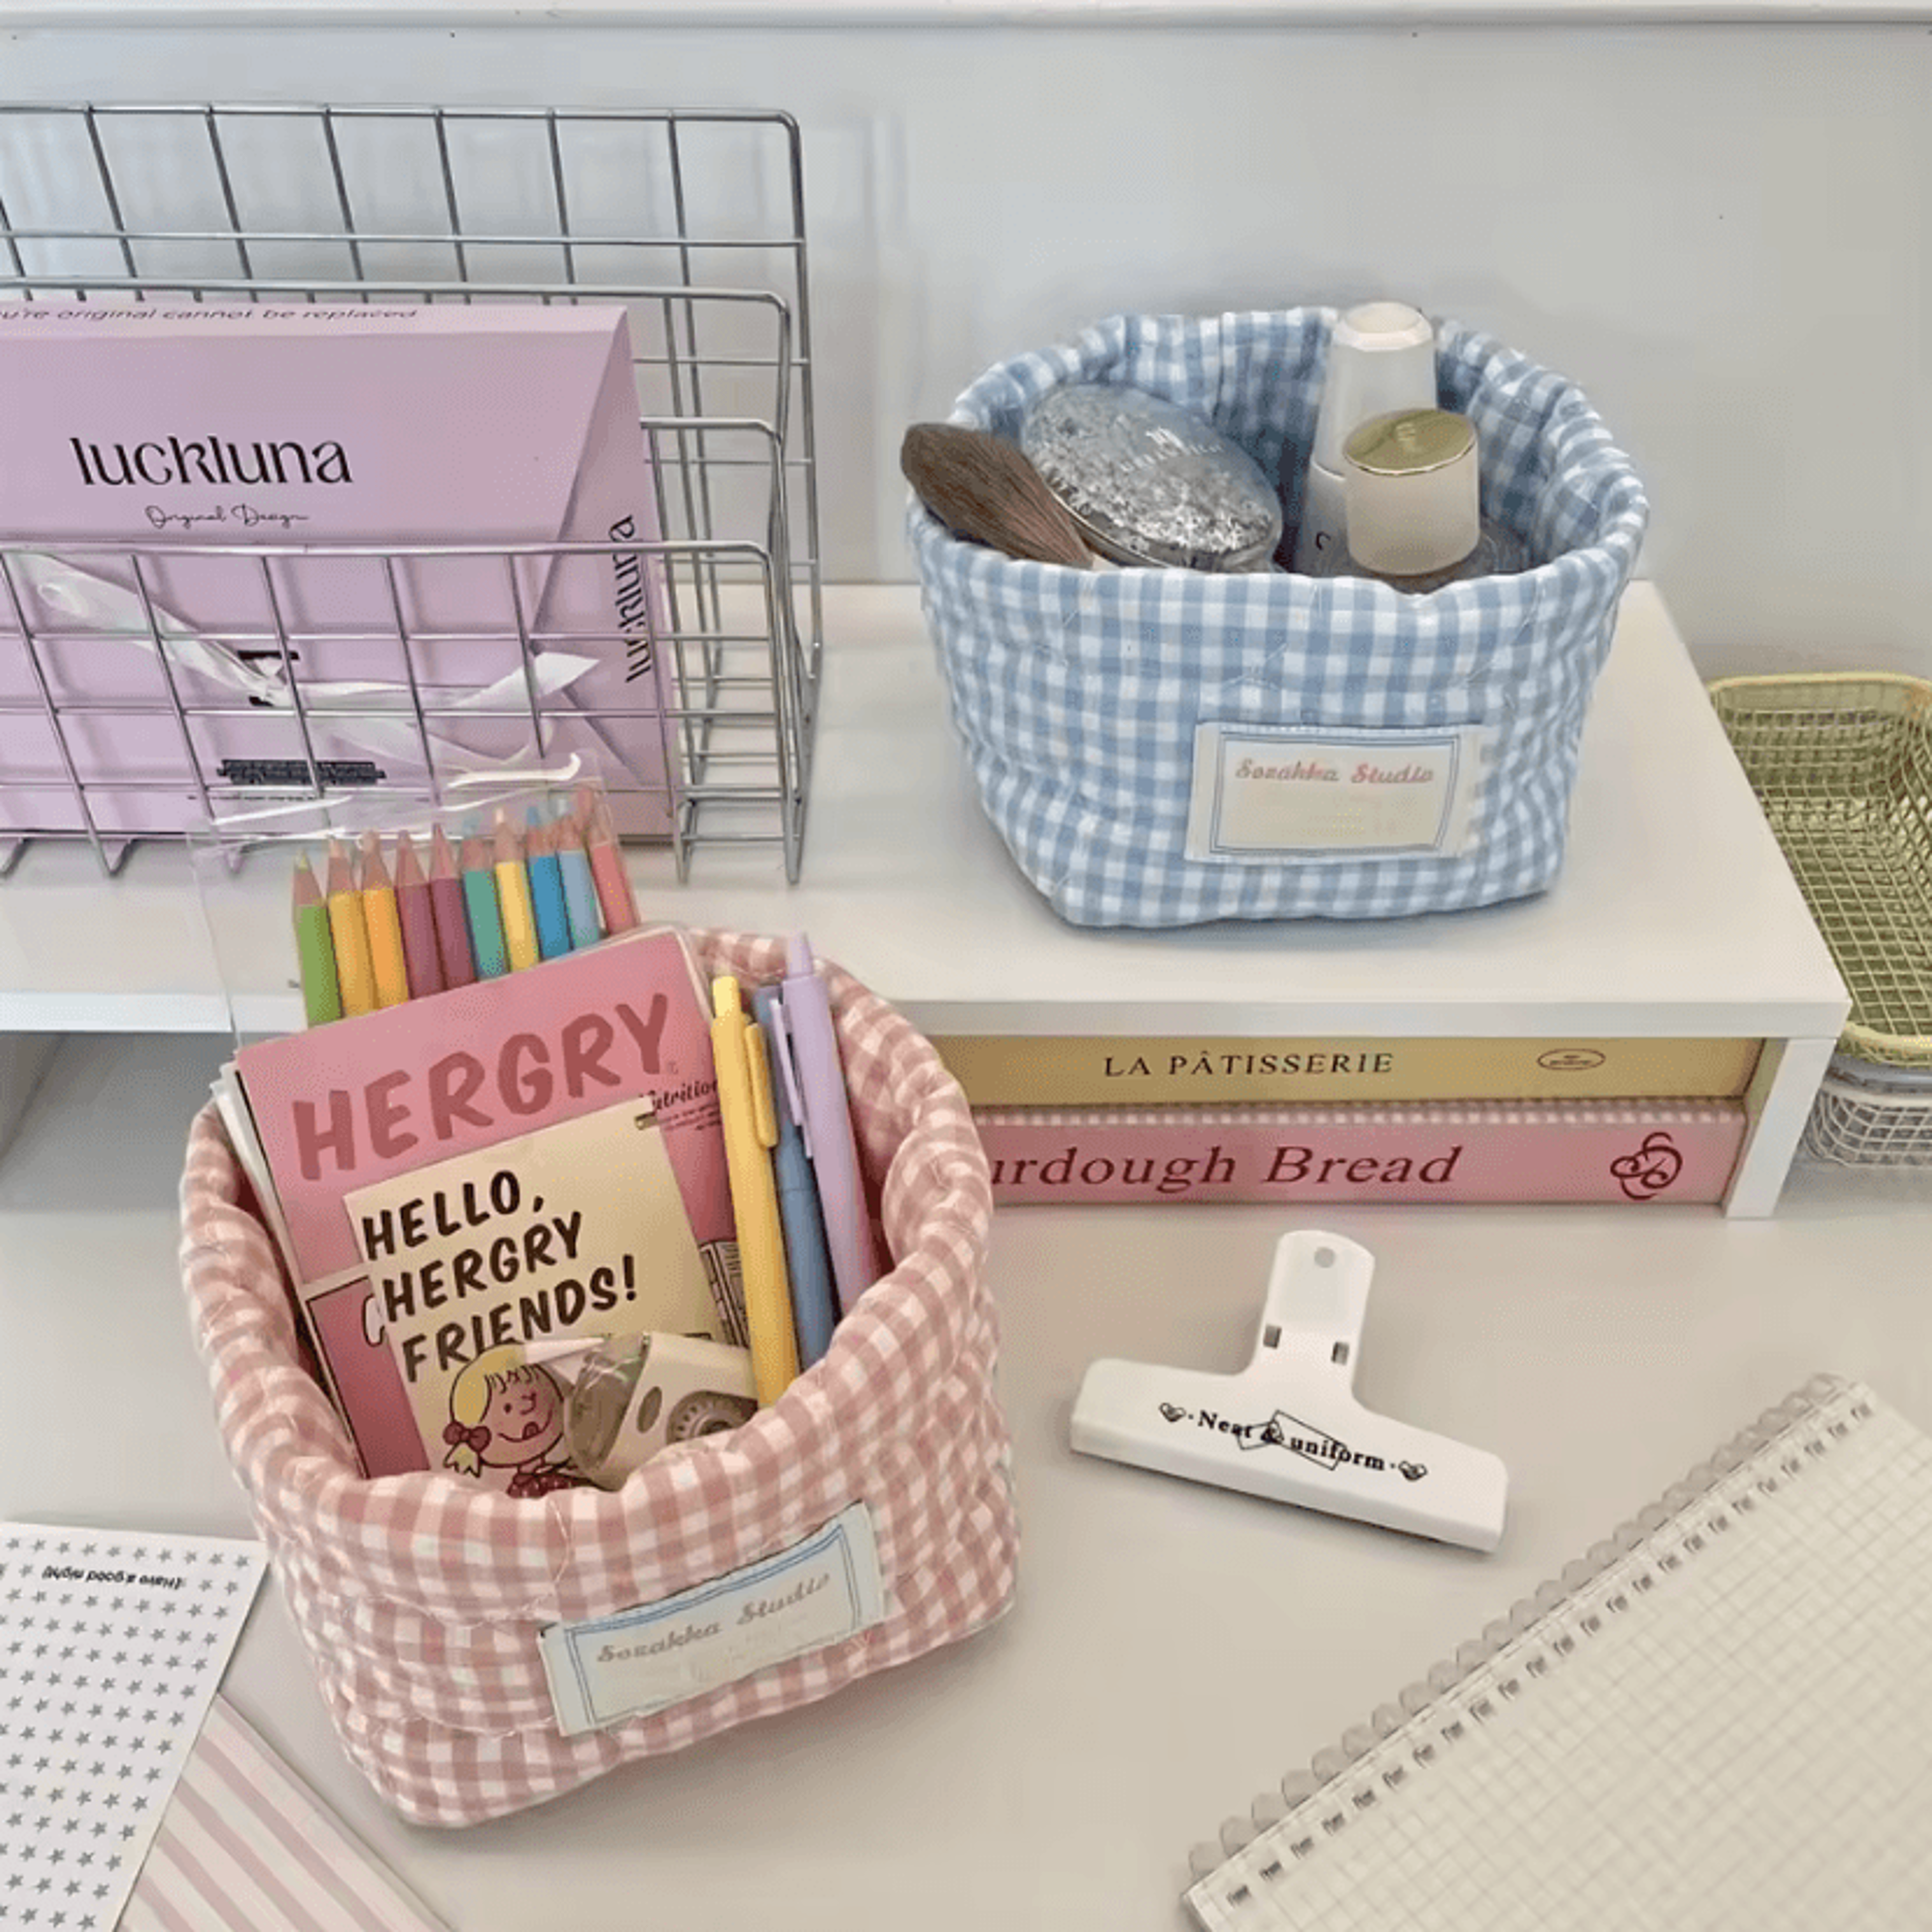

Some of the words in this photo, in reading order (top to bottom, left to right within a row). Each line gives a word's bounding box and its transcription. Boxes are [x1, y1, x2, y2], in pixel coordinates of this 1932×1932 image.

[0, 307, 49, 319] u're
[58, 308, 157, 320] original
[163, 309, 253, 319] cannot
[263, 309, 295, 319] be
[303, 309, 417, 320] replaced
[69, 436, 353, 485] luckluna
[1351, 762, 1433, 784] Studio
[291, 992, 669, 1181] HERGRY
[1105, 1056, 1151, 1077] LA
[1169, 1050, 1394, 1075] PÂTISSERIE
[1262, 1146, 1463, 1184] Bread
[362, 1170, 544, 1261] HELLO,
[382, 1210, 582, 1323] HERGRY
[402, 1254, 637, 1383] FRIENDS!
[1197, 1410, 1252, 1439] Neat
[1260, 1418, 1284, 1445] &
[1290, 1435, 1385, 1471] uniform
[85, 1569, 124, 1584] good
[125, 1573, 137, 1583] a
[736, 1573, 830, 1626] Studio
